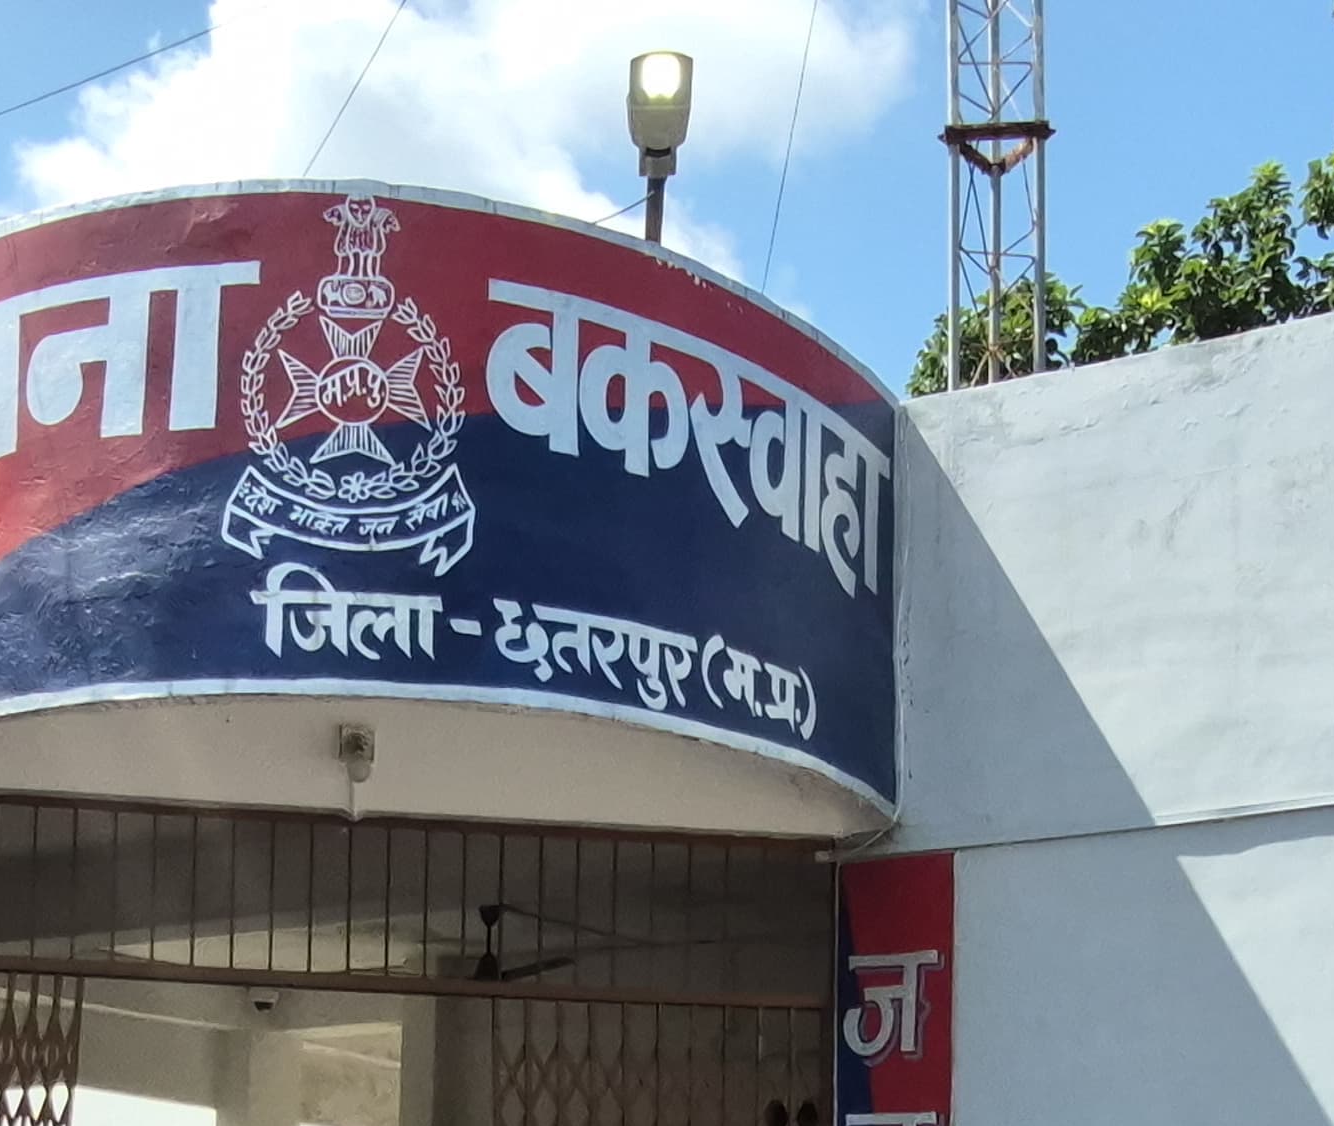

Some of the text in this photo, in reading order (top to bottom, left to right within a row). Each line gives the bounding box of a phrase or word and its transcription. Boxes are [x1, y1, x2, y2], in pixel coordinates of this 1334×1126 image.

[486, 279, 891, 599] बकस्वाहा
[358, 516, 400, 536] जन
[249, 562, 443, 660] जिला
